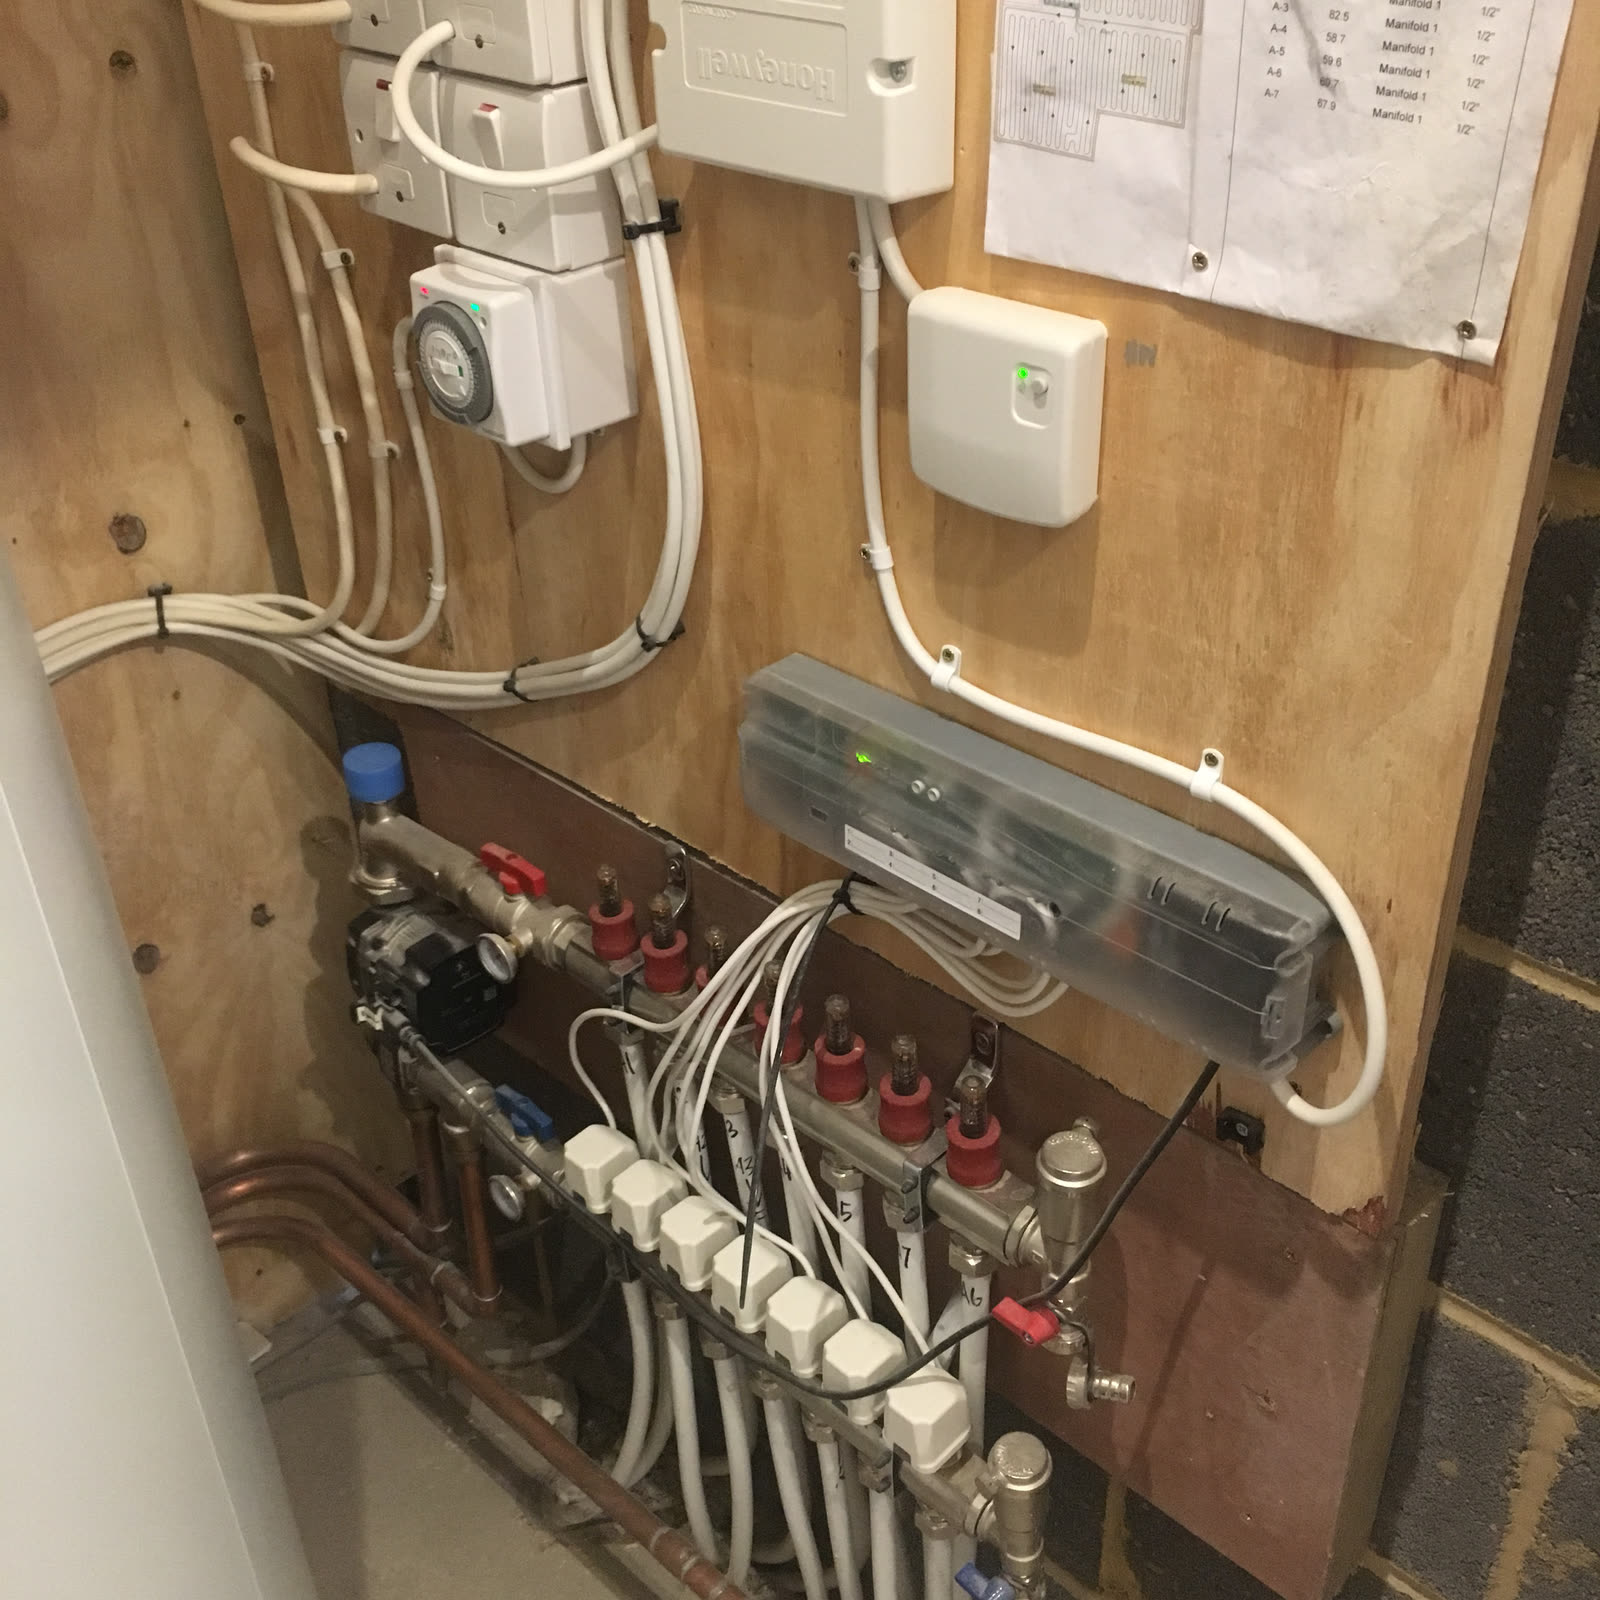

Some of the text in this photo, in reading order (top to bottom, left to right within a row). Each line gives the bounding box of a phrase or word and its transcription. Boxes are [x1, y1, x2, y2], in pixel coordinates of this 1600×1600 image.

[1272, 2, 1289, 12] A-3
[1385, 18, 1430, 33] Manifold
[1270, 24, 1288, 34] A-4
[1382, 41, 1426, 56] Manifold
[697, 47, 836, 103] Honeywell
[1268, 45, 1286, 56] A-5
[1379, 63, 1423, 78] Manifold
[1266, 66, 1283, 78] A-6
[1376, 85, 1419, 101] Manifold
[1264, 88, 1280, 98] A-7
[1372, 108, 1415, 123] Manifold
[725, 1119, 738, 1138] 3
[840, 1200, 852, 1222] 5
[901, 1245, 911, 1269] 7
